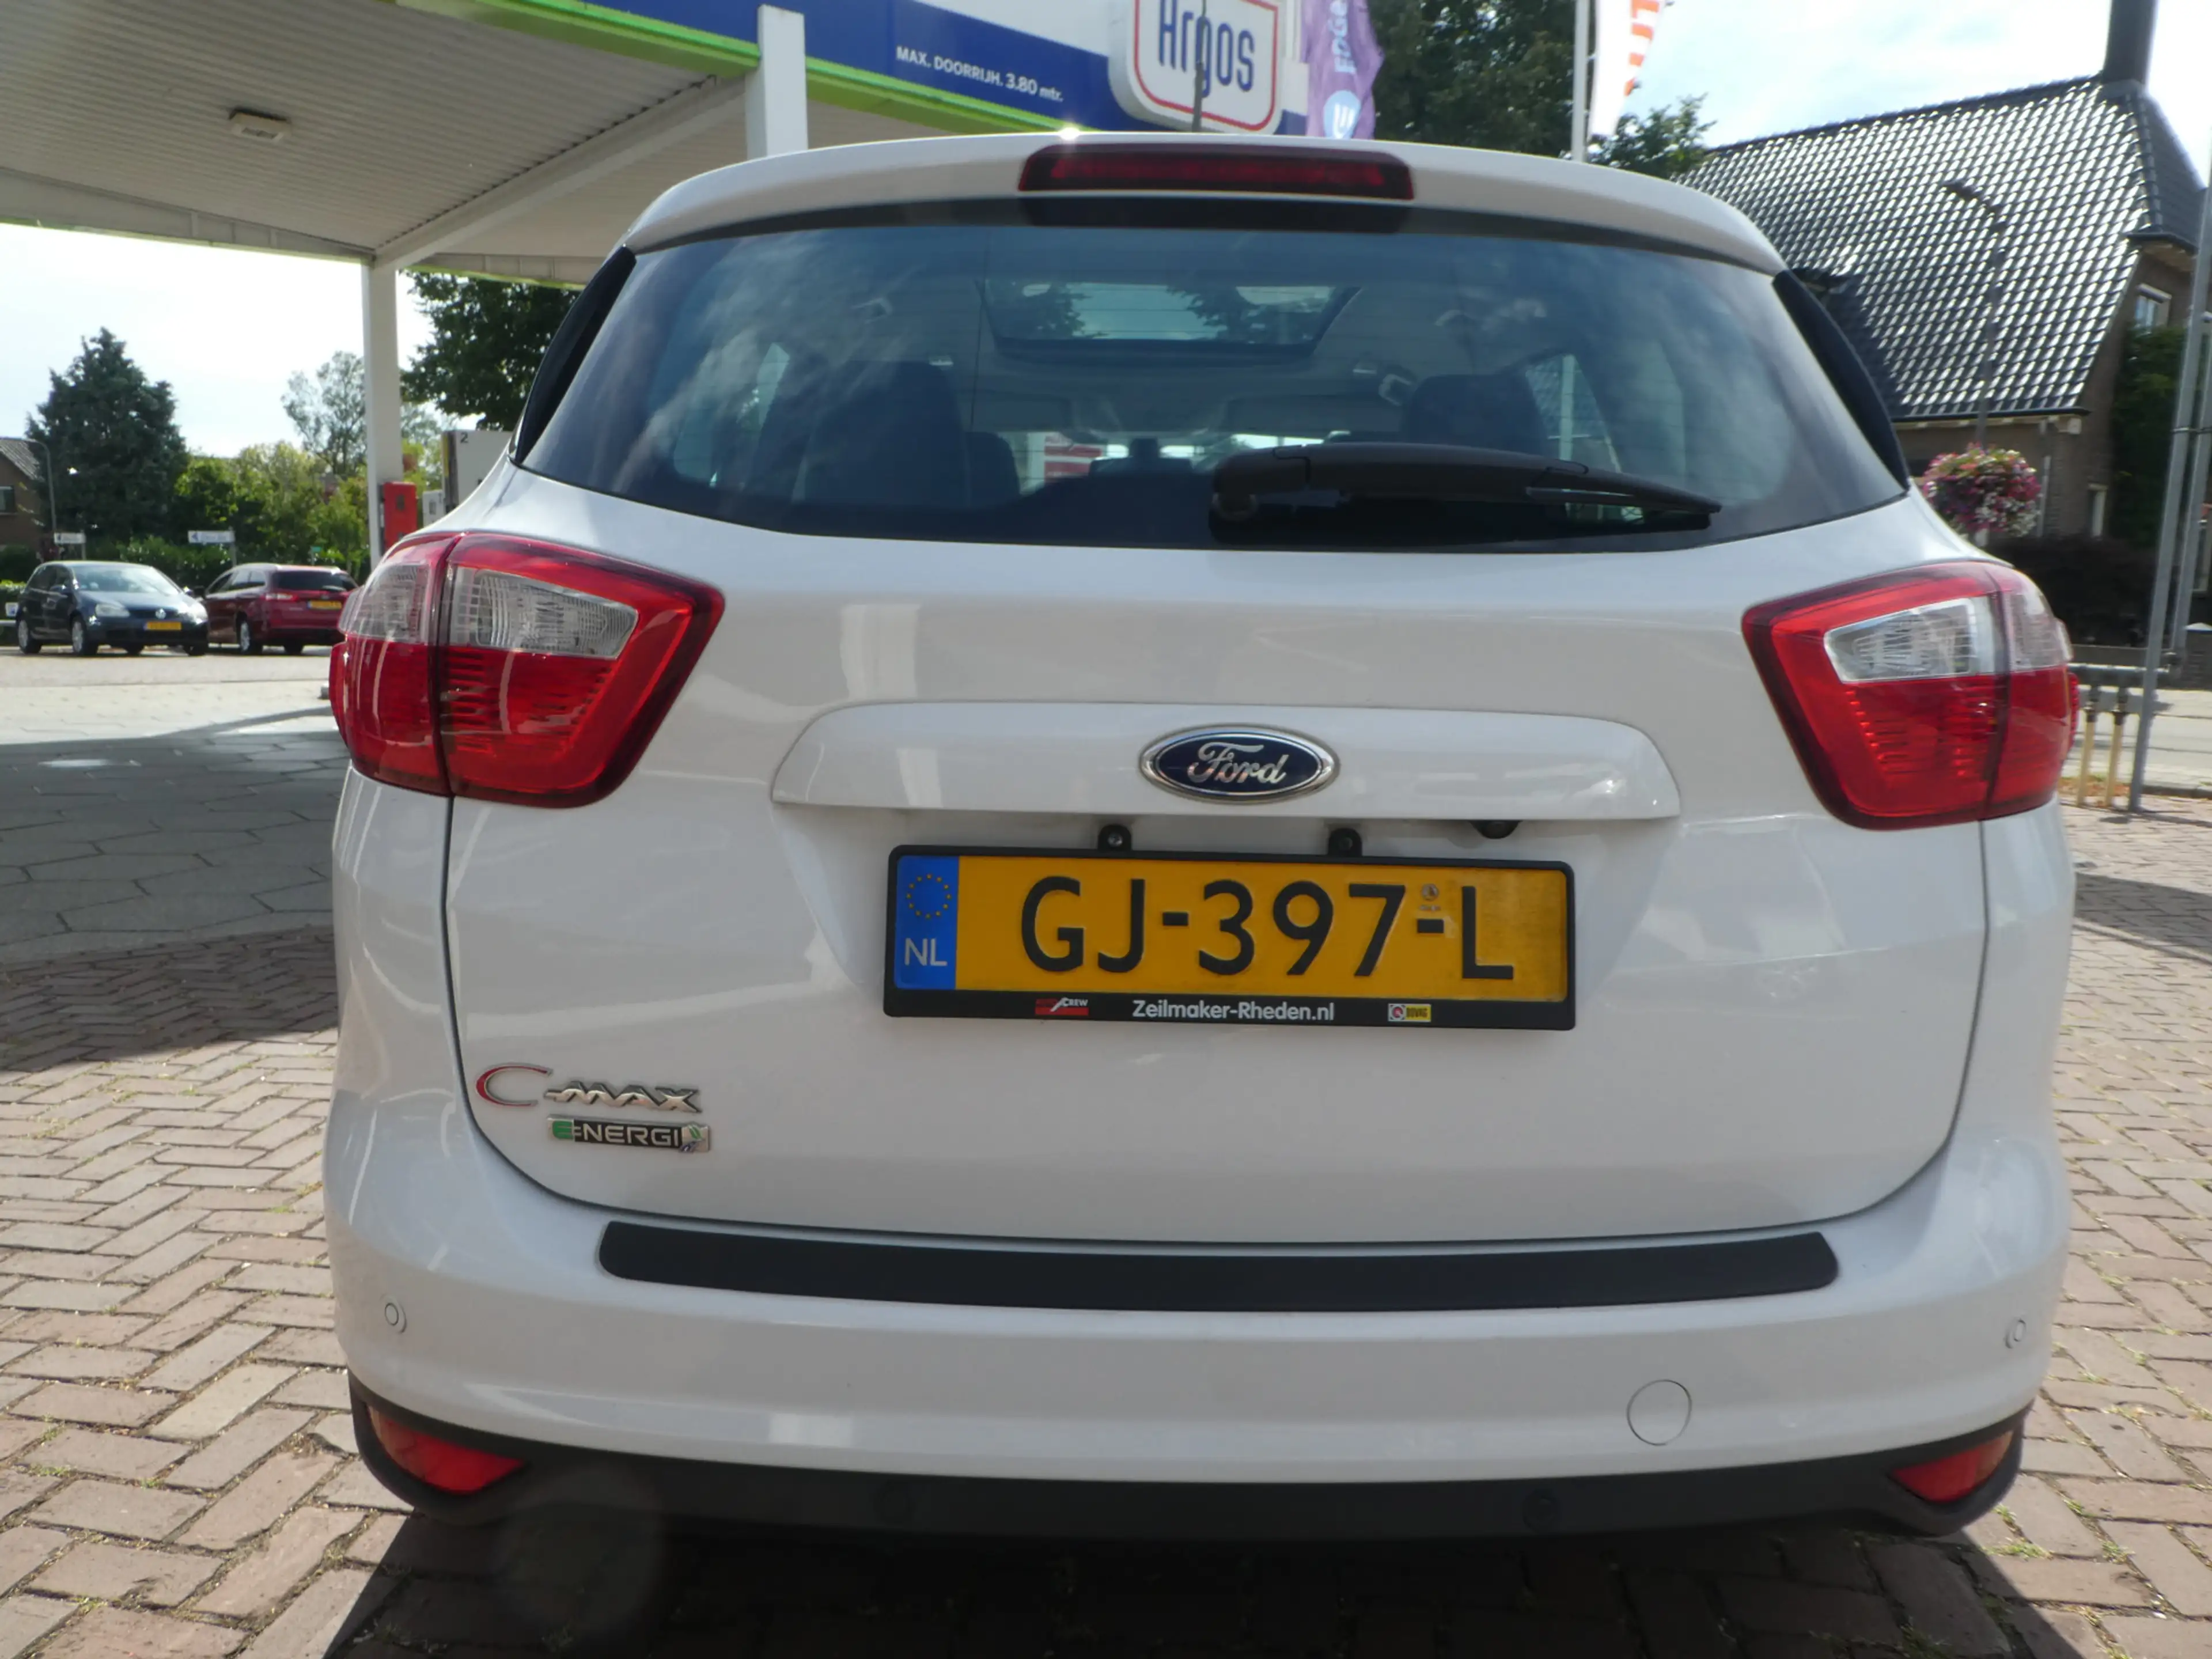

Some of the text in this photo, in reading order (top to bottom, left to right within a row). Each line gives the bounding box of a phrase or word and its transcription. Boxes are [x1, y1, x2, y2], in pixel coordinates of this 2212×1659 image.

[896, 46, 1064, 102] MAX. DOORRIJH. 3.80 mtr.
[460, 431, 469, 444] 2
[1187, 741, 1290, 784] Ford
[1021, 876, 1514, 981] GJ-397-L
[904, 937, 948, 967] NL
[1131, 999, 1335, 1021] Zeilmaker-Rheden.nl
